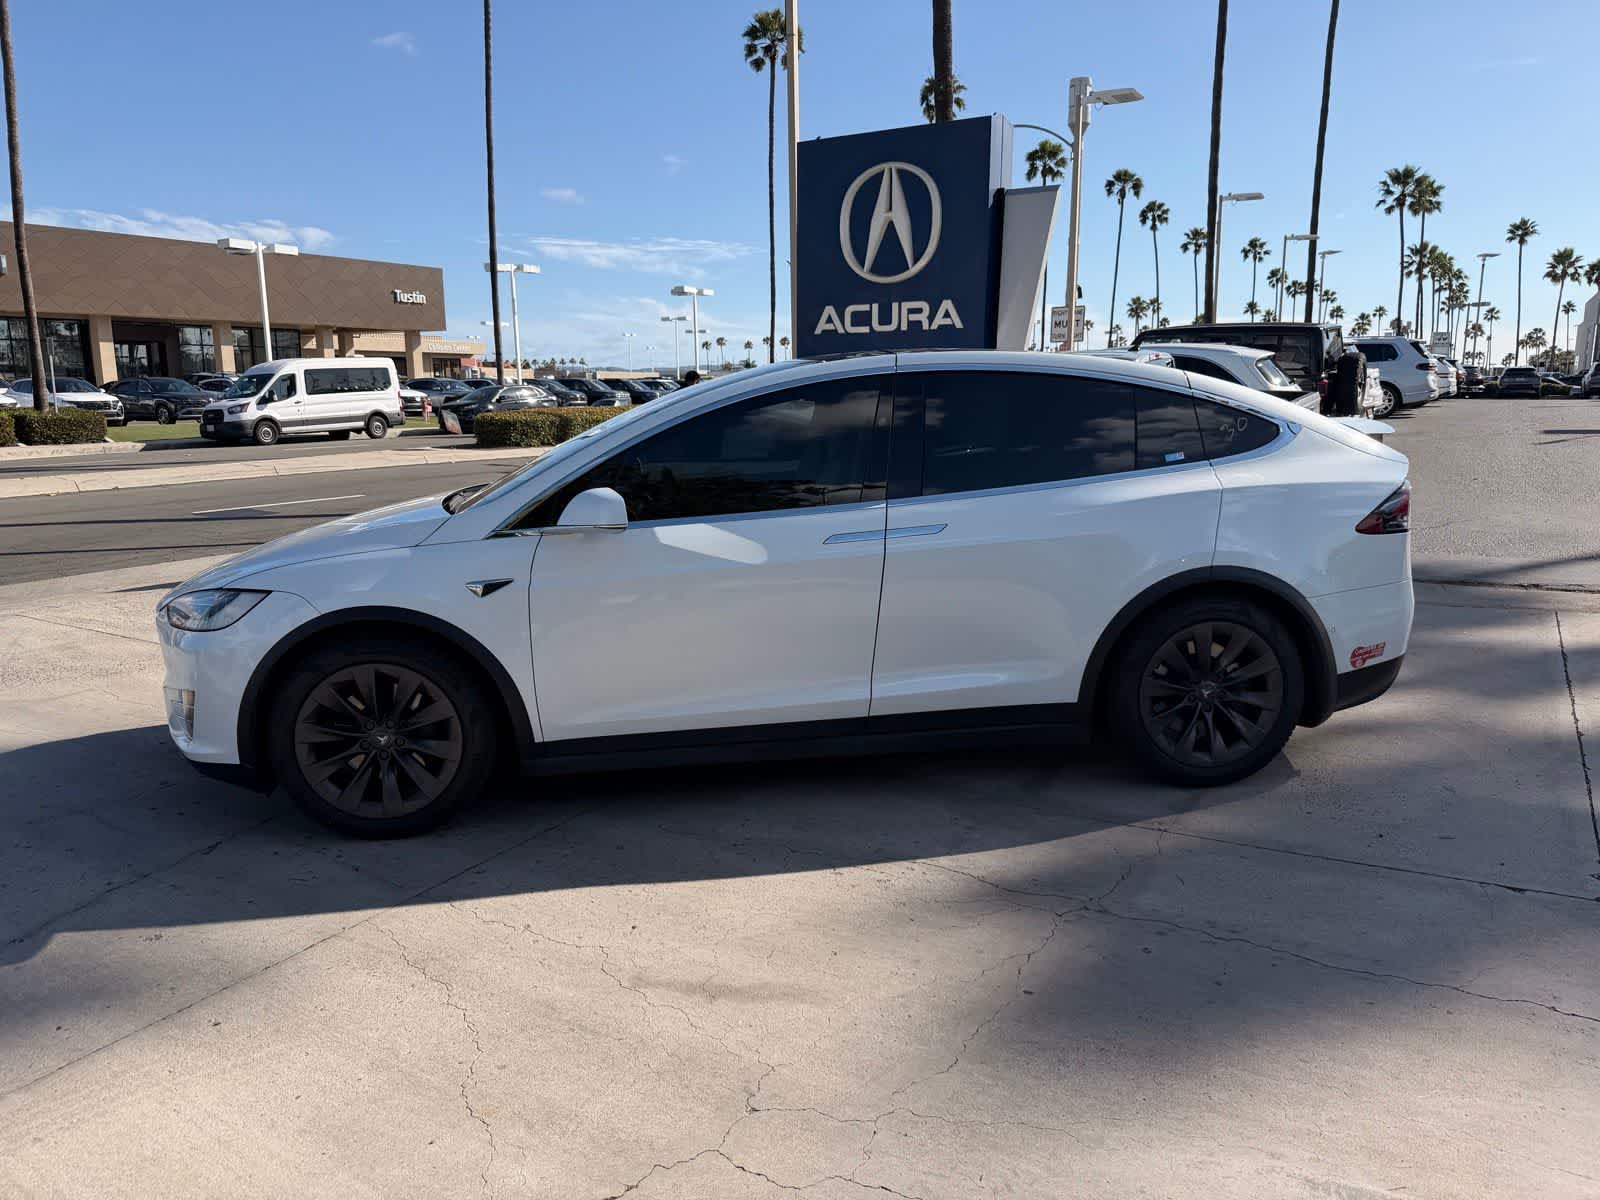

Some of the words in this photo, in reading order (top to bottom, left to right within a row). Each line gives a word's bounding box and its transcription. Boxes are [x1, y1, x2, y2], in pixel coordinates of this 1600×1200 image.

[394, 290, 426, 304] Tustin
[814, 300, 964, 335] ACURA
[1054, 320, 1081, 329] MUT
